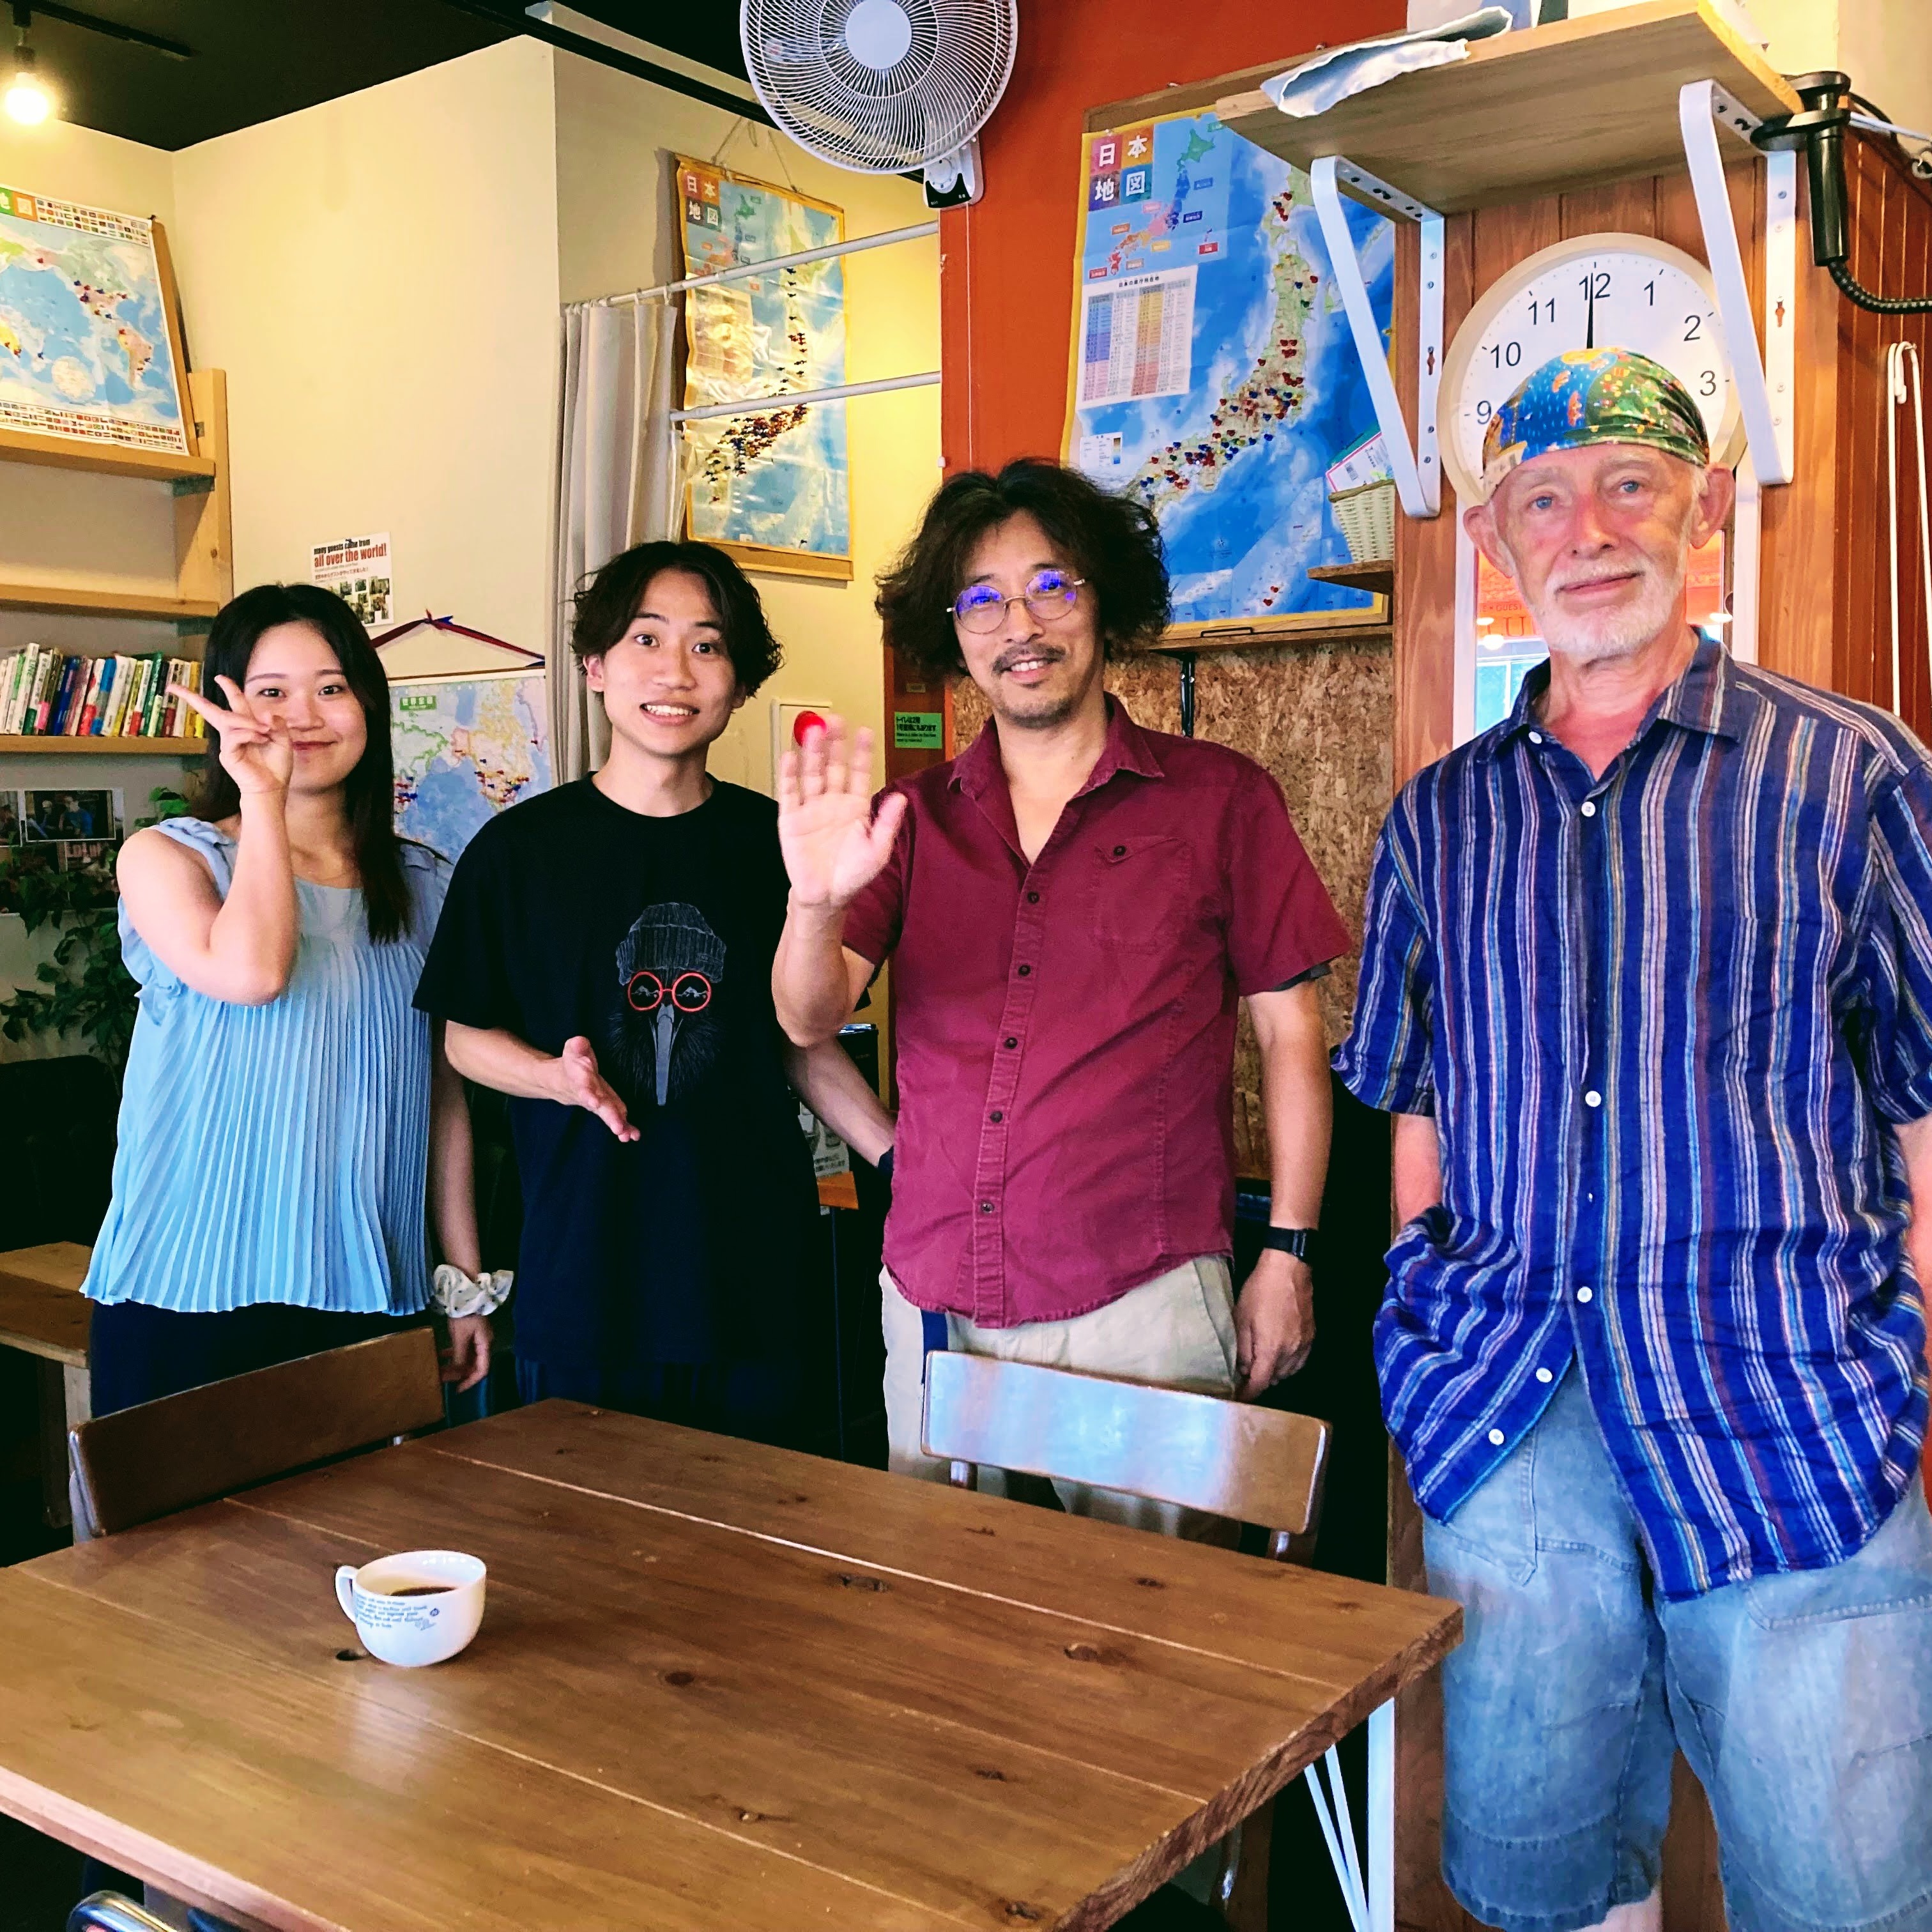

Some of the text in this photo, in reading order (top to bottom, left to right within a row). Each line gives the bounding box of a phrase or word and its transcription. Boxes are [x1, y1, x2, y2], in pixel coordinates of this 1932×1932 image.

[1098, 135, 1148, 167] 日本
[687, 175, 716, 197] 日本
[1095, 171, 1146, 201] 地図
[689, 201, 719, 226] 地図
[1579, 273, 1611, 300] 12
[1644, 280, 1653, 306] 1
[1528, 298, 1554, 325] 11
[1683, 315, 1701, 341] 2
[1491, 342, 1521, 368] 10
[1699, 370, 1716, 396] 3
[1476, 400, 1492, 425] 9
[314, 554, 324, 567] all
[326, 553, 344, 566] over
[345, 549, 359, 562] the
[360, 543, 387, 560] world!
